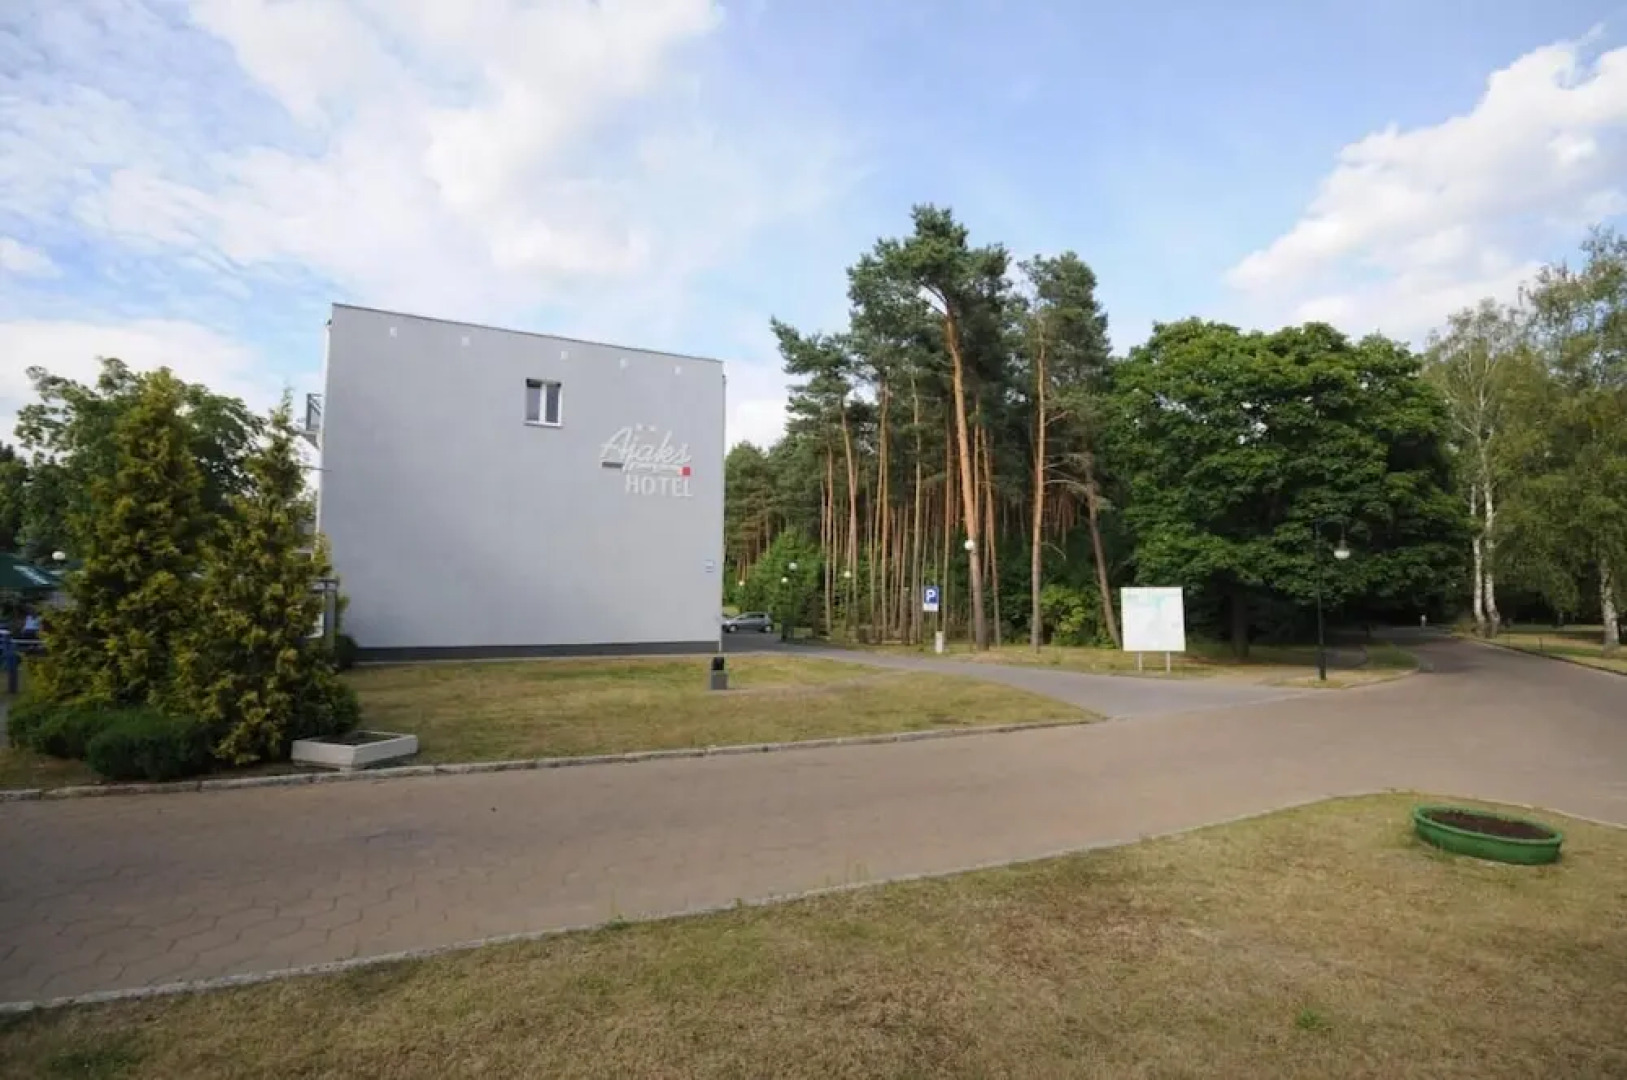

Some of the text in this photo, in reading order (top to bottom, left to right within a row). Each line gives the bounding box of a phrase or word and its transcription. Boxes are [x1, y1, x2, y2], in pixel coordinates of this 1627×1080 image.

[601, 426, 692, 473] Ajaks
[626, 474, 692, 497] HOTEL
[925, 588, 936, 603] P
